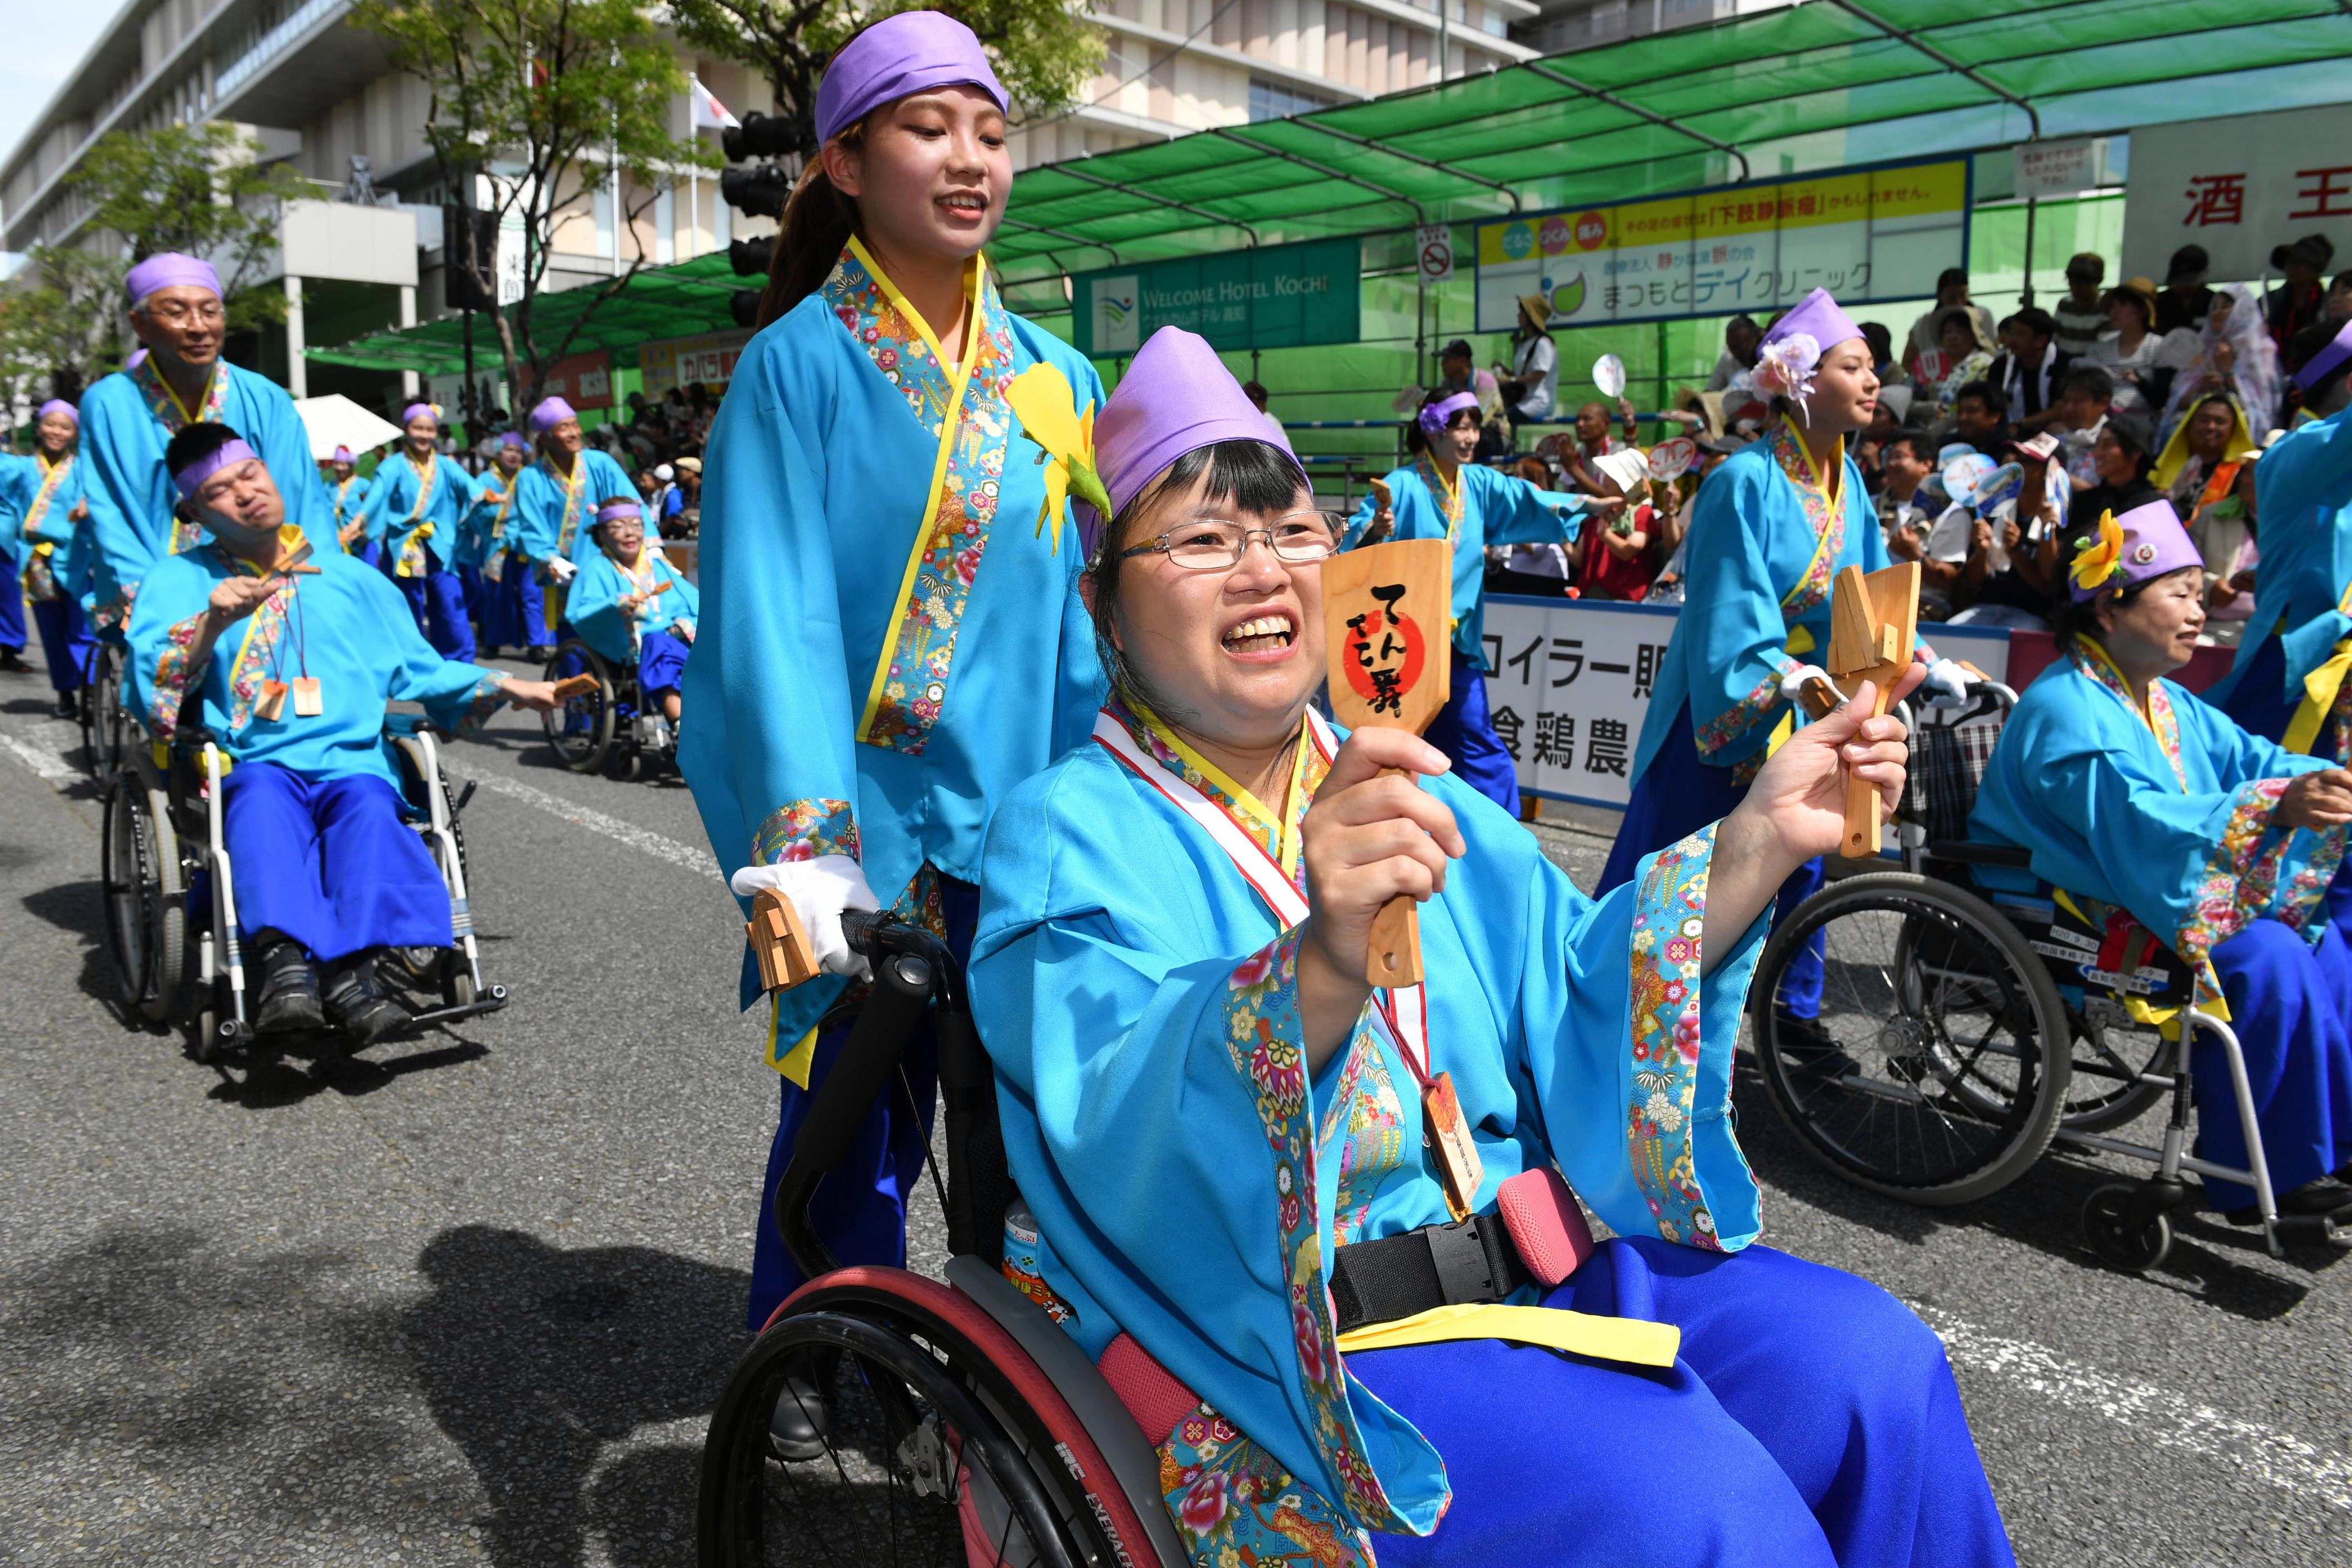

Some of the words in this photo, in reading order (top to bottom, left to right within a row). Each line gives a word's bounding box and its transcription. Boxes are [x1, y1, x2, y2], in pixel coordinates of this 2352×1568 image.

[1603, 262, 1872, 310] まつもとデイクリニック
[1014, 1230, 1037, 1245] たっぷり
